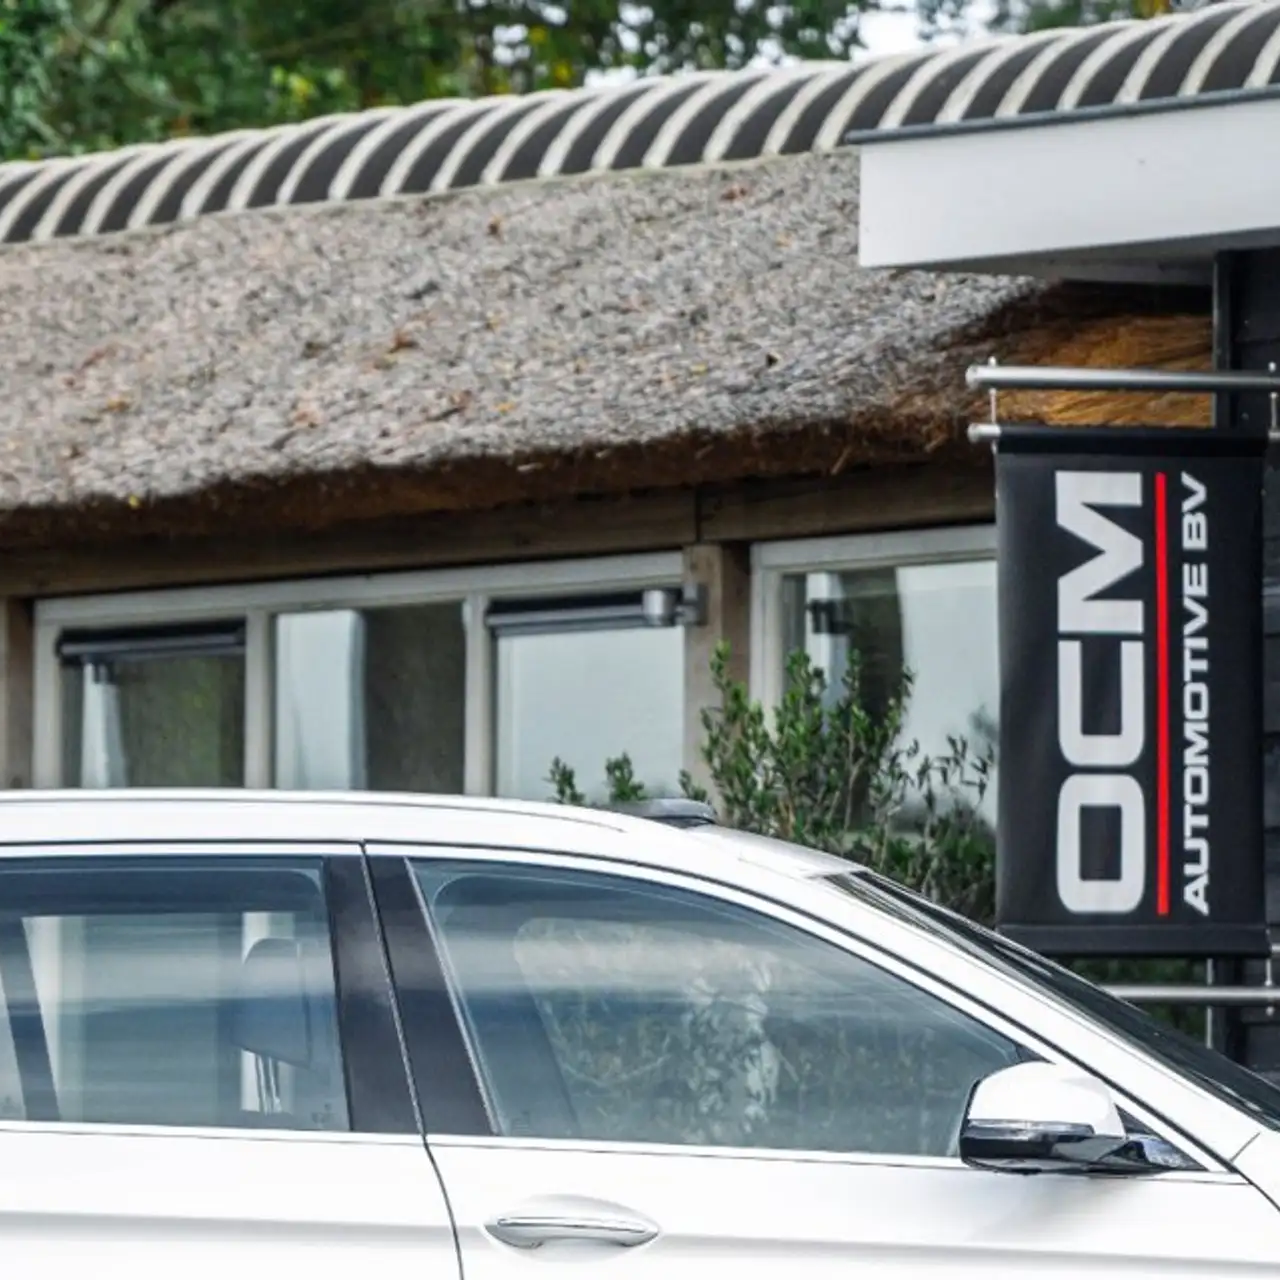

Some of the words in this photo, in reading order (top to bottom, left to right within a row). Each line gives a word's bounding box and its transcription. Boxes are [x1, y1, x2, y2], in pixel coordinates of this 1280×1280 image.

[1180, 471, 1209, 551] BV
[1055, 470, 1146, 914] OCM
[1182, 562, 1210, 917] AUTOMOTIVE
